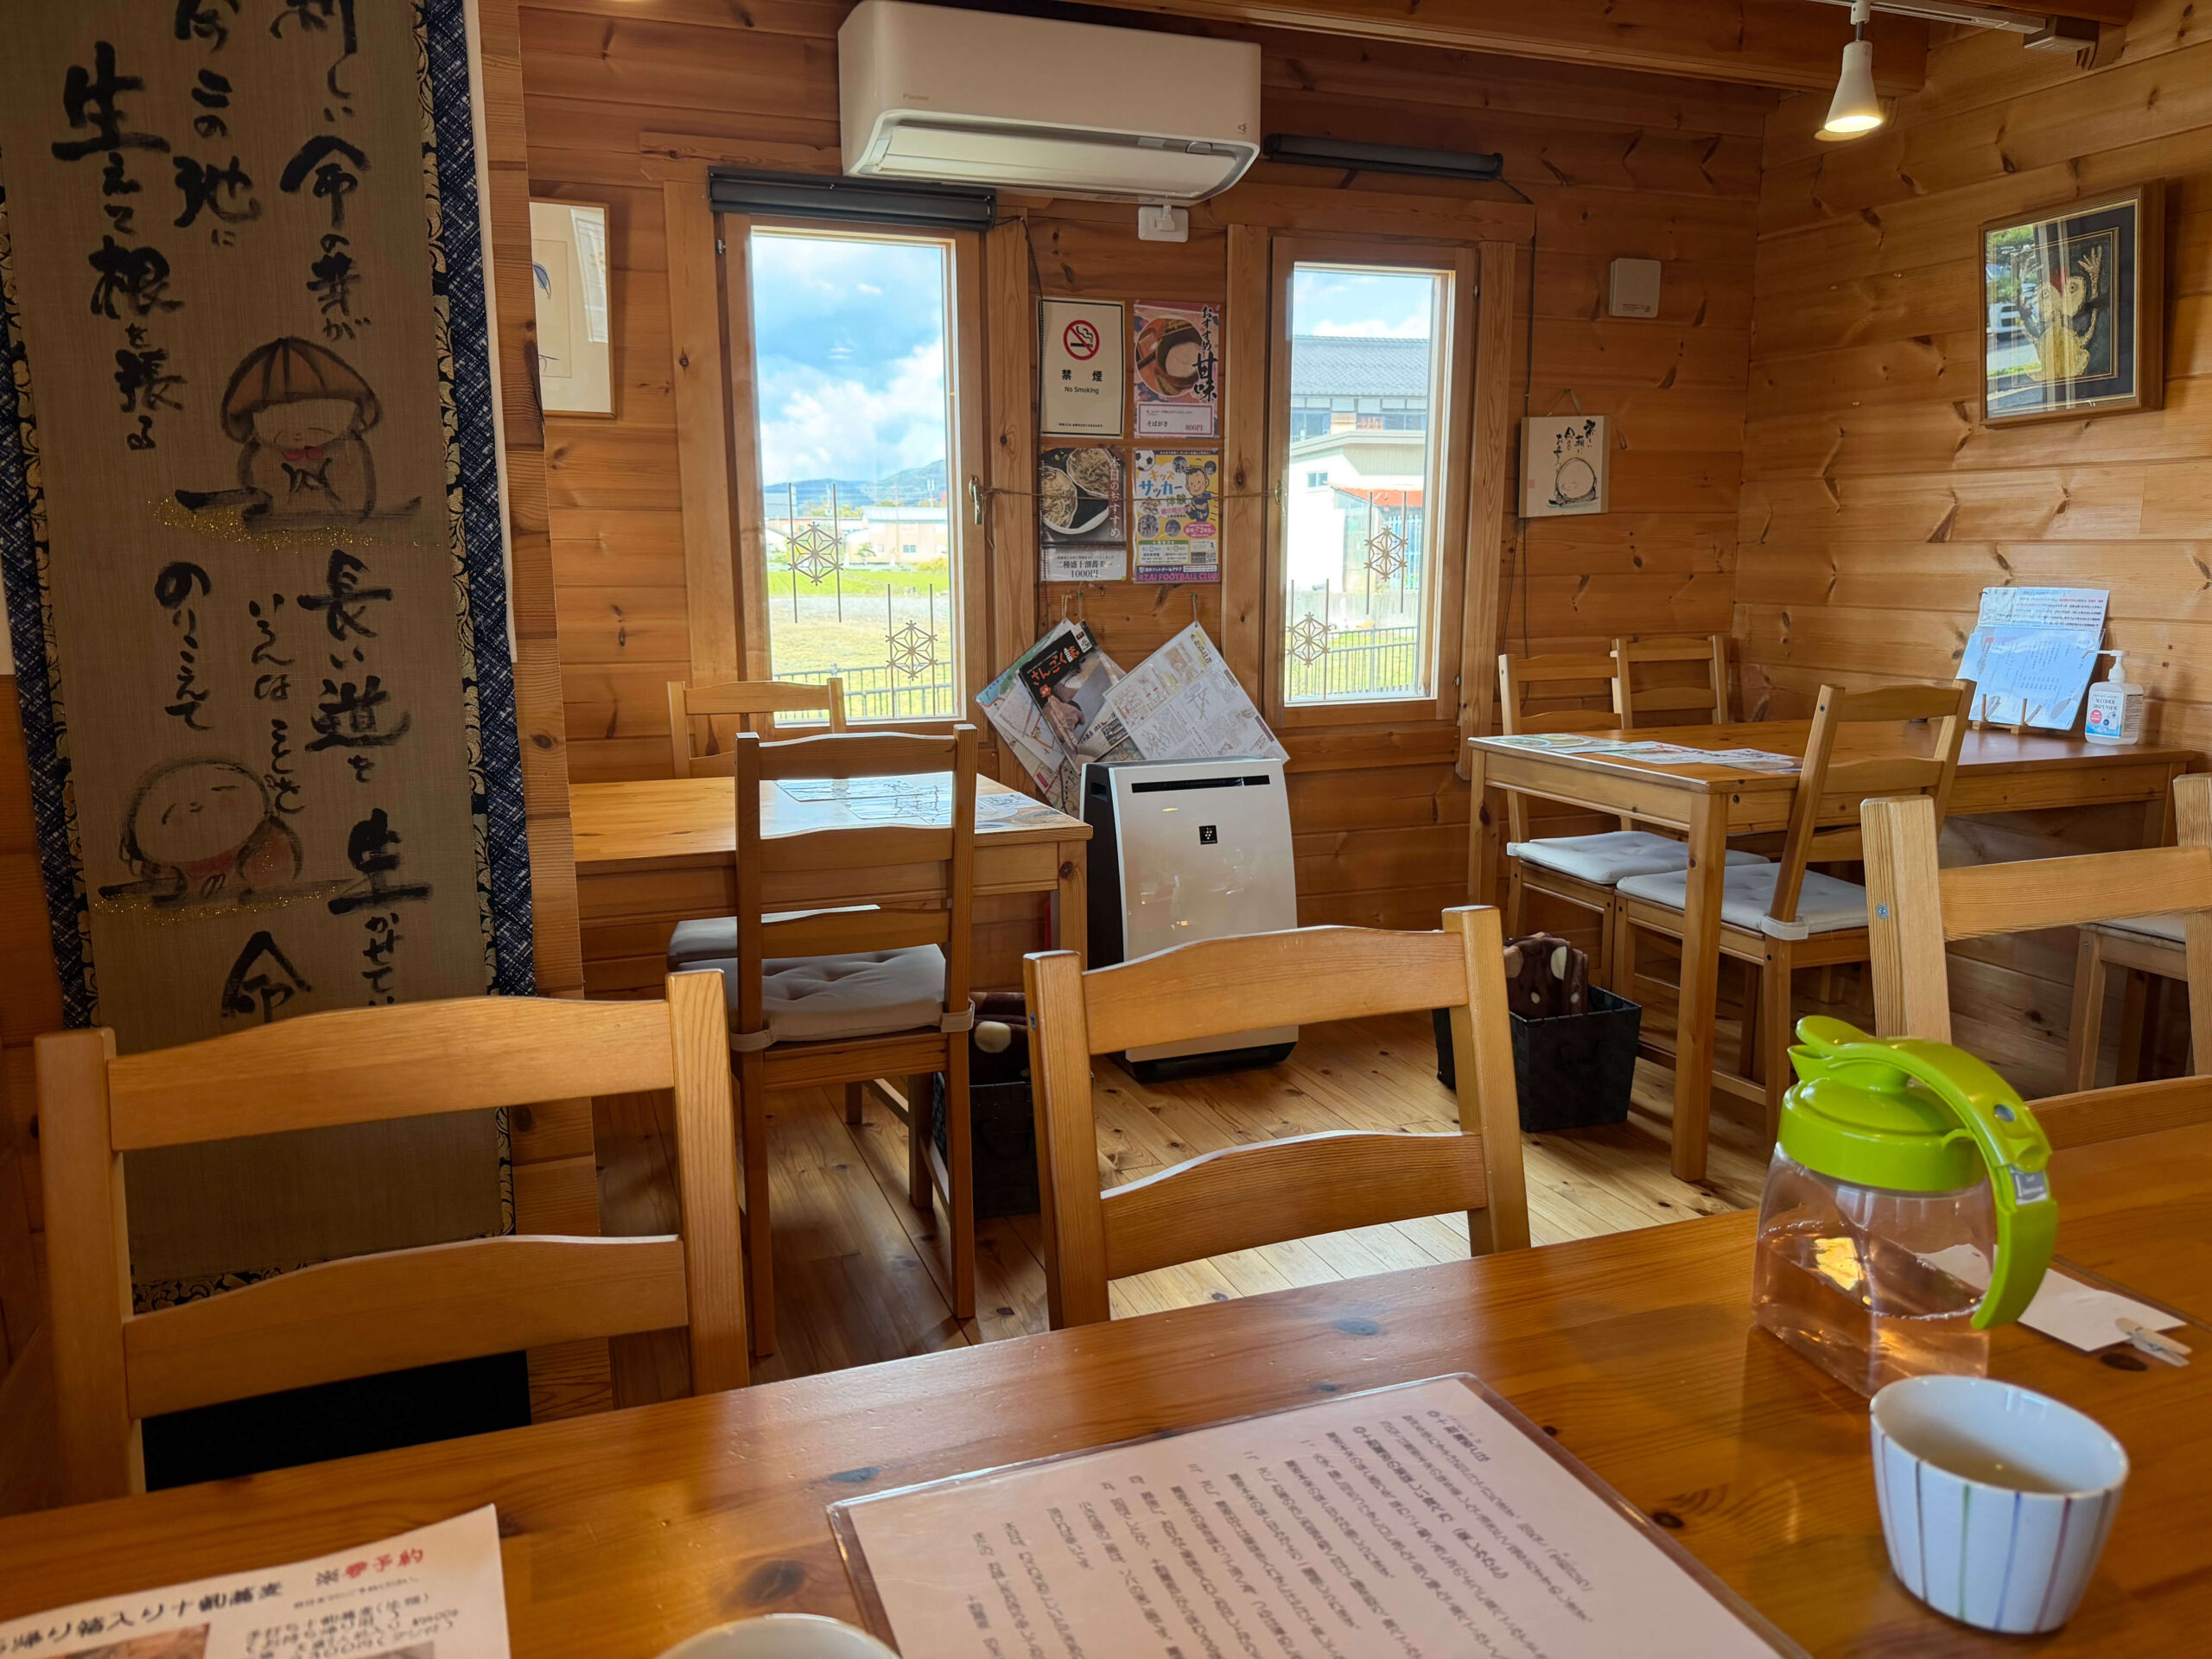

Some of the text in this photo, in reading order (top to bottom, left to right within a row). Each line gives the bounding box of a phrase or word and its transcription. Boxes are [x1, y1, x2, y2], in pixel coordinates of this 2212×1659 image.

[1074, 386, 1099, 395] Smoking
[1139, 480, 1183, 498] サッカー
